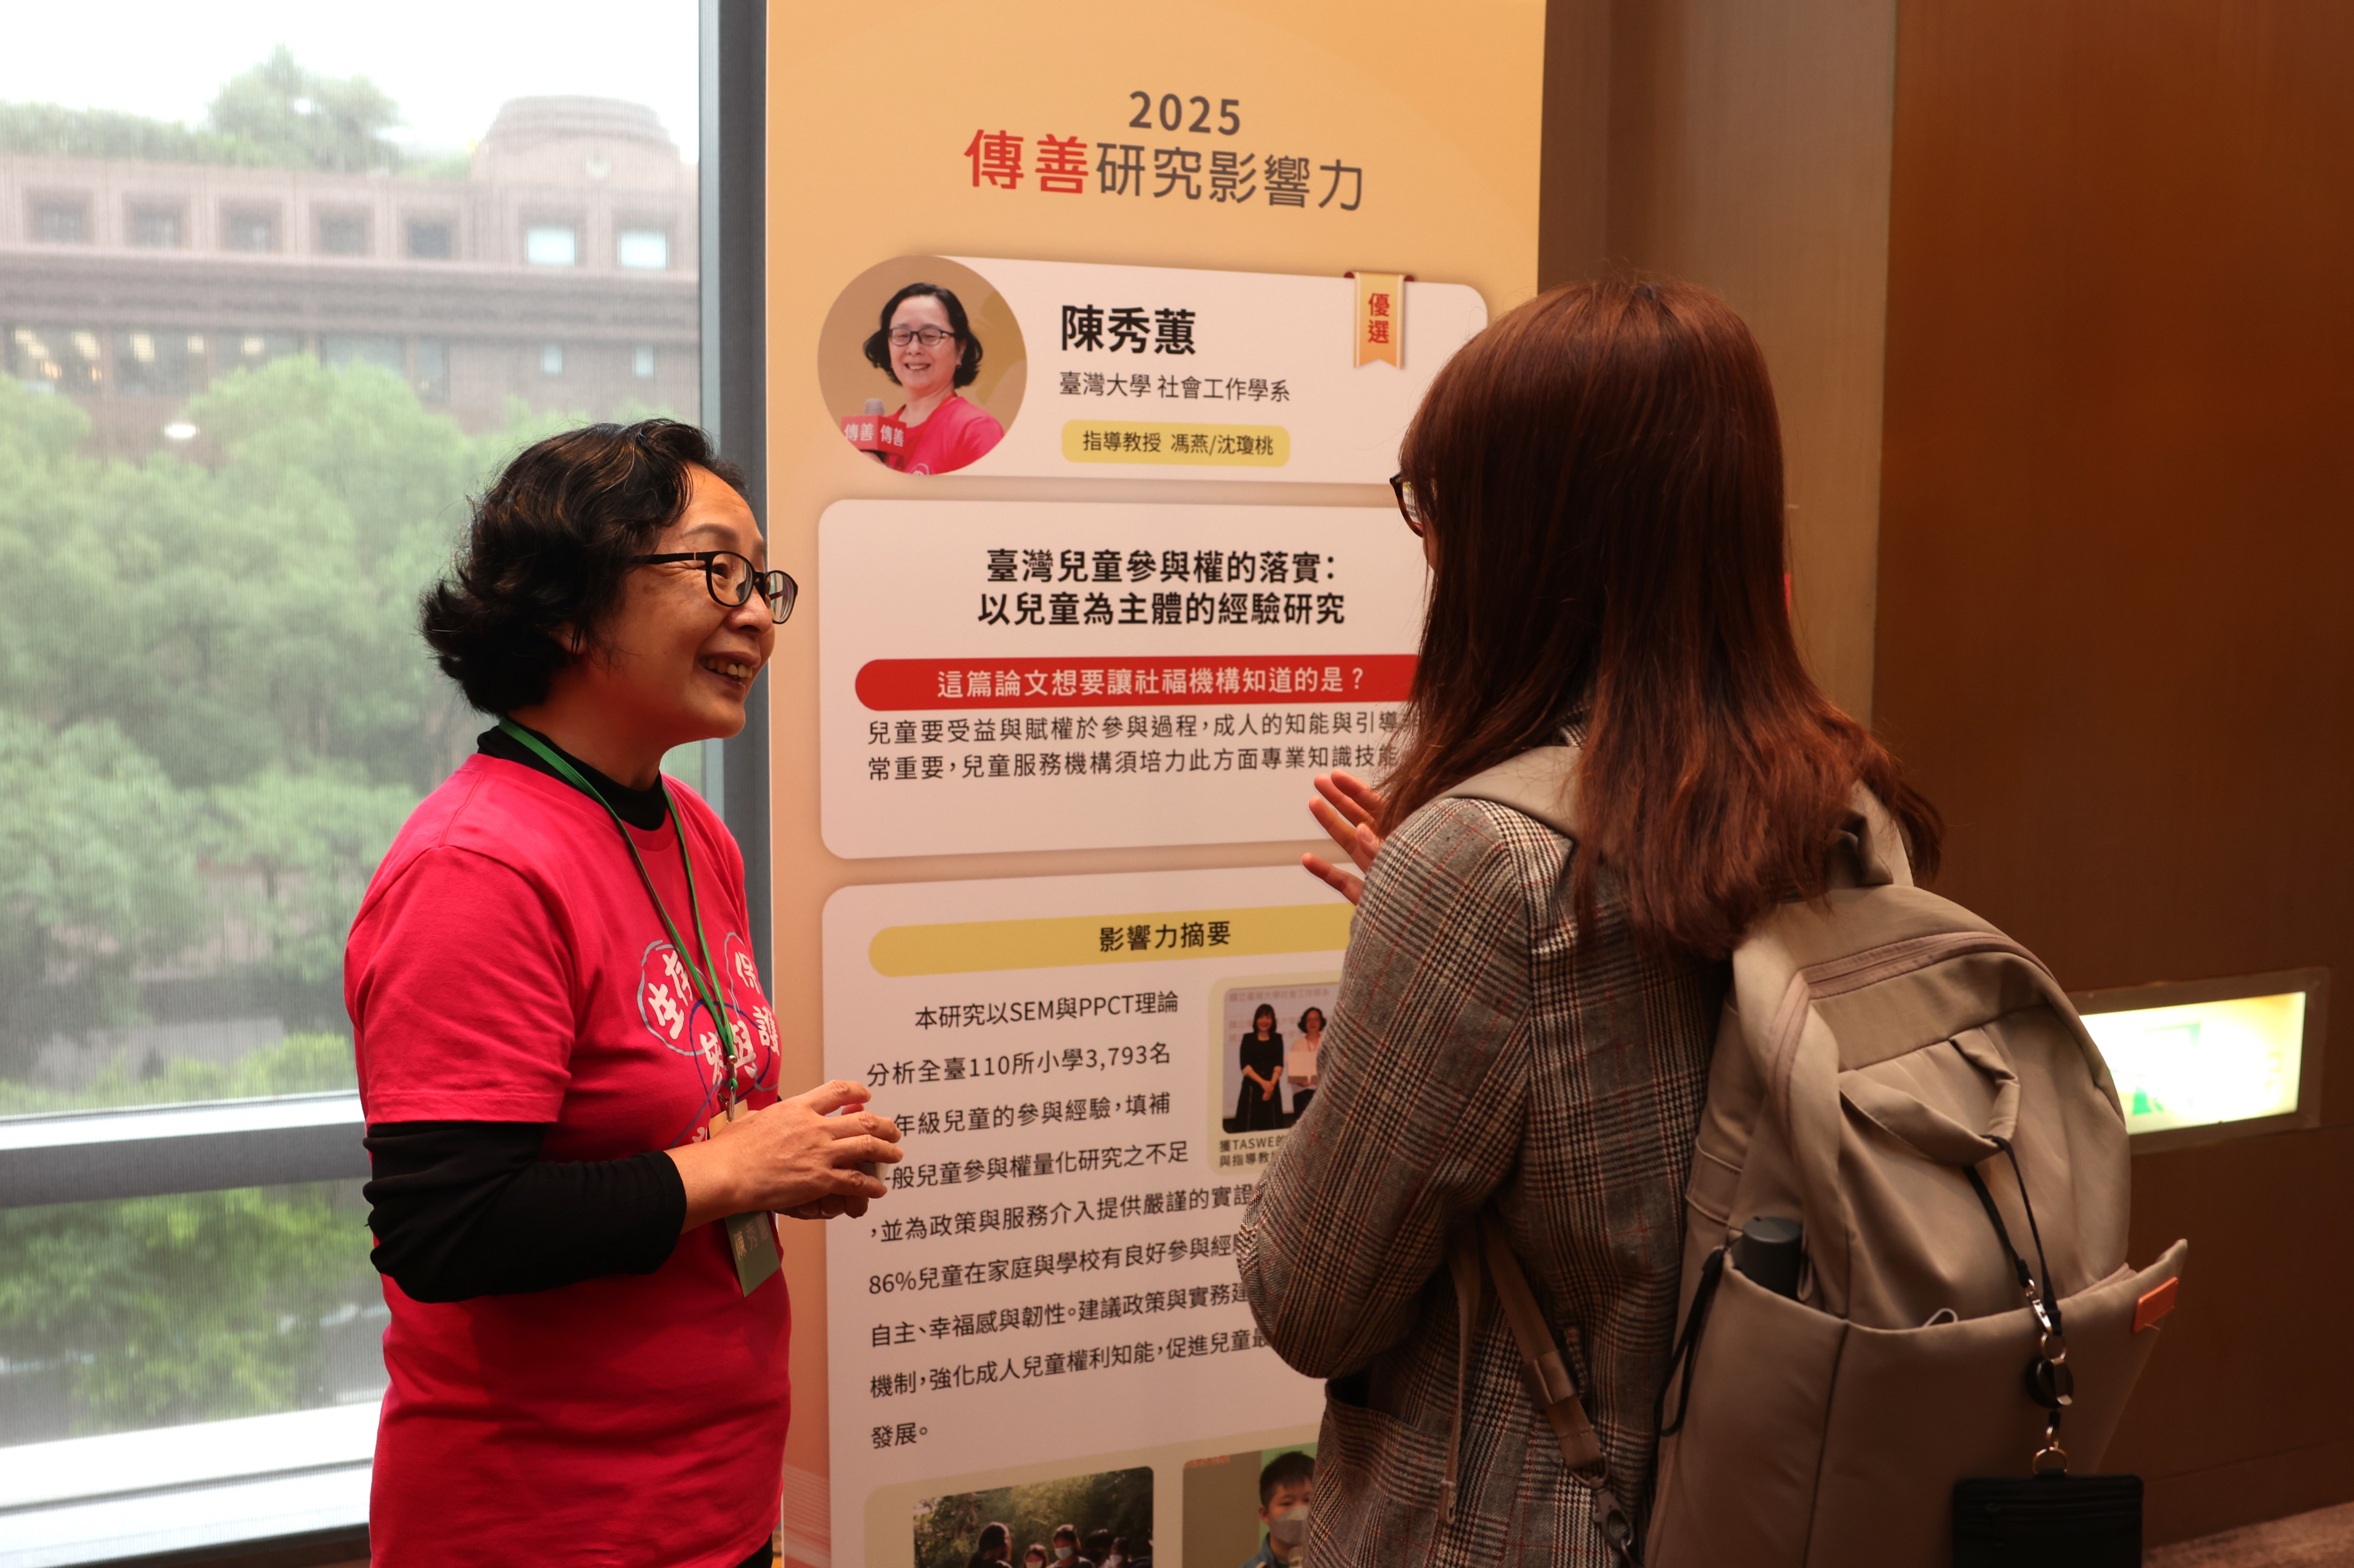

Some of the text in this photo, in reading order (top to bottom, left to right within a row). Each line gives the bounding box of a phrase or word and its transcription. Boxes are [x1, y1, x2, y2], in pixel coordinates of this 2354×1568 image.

[1129, 91, 1241, 136] 2025
[964, 129, 1362, 211] 傳善研究影響力
[1062, 304, 1196, 355] 陳秀蕙
[1368, 292, 1390, 344] 優選
[1060, 371, 1290, 402] 臺灣大學 社會工作學系
[880, 424, 904, 447] 傳善
[1083, 430, 1274, 456] 指導教授 馮燕/沈瓊桃
[987, 548, 1335, 583] 臺灣兒童參與權的落實：
[978, 591, 1344, 626] 以兒童為主體的經驗研究
[937, 666, 1364, 698] 這篇論文想要讓社福機構知道的是？
[868, 710, 1415, 745] 兒童要受益與賦權於參與過程，成人的知能與引導
[1099, 921, 1231, 952] 影響力摘要
[915, 990, 1178, 1030] 本研究以SEM與PPCT理論
[867, 1042, 1170, 1087] 分析全臺110所小學3,793名
[1219, 1151, 1275, 1167] 與指導教
[869, 1234, 1238, 1294] 86%兒童在家庭與學校有良好參與經
[871, 1422, 927, 1449] 發展。
